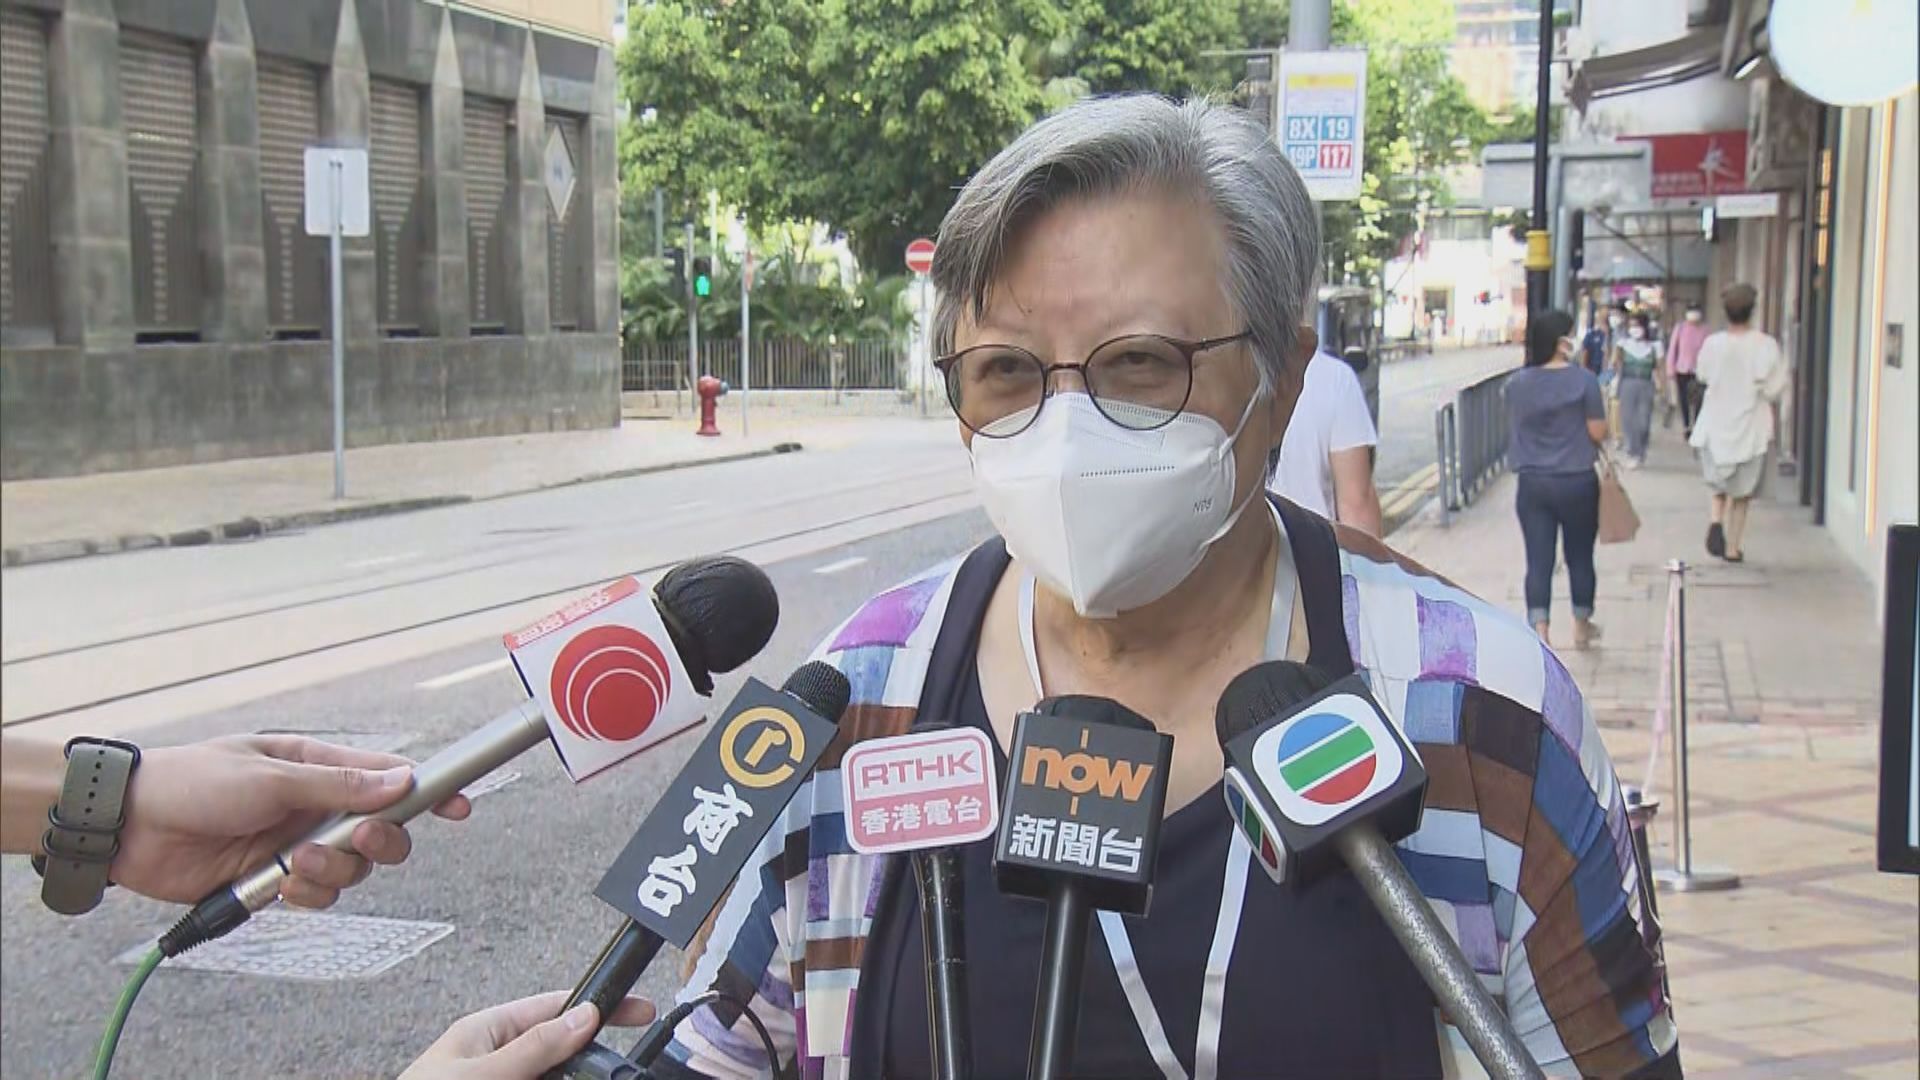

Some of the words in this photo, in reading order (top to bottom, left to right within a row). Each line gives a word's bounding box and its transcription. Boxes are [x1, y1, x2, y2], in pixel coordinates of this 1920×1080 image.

[1289, 117, 1317, 139] 8X
[1327, 117, 1348, 139] 19
[1289, 145, 1316, 168] 19P
[1321, 145, 1351, 168] 117
[861, 751, 976, 789] RTHK
[1021, 746, 1154, 802] now
[861, 796, 982, 836] 香港電台
[637, 782, 754, 918] 商台
[1009, 814, 1143, 874] 新聞台
